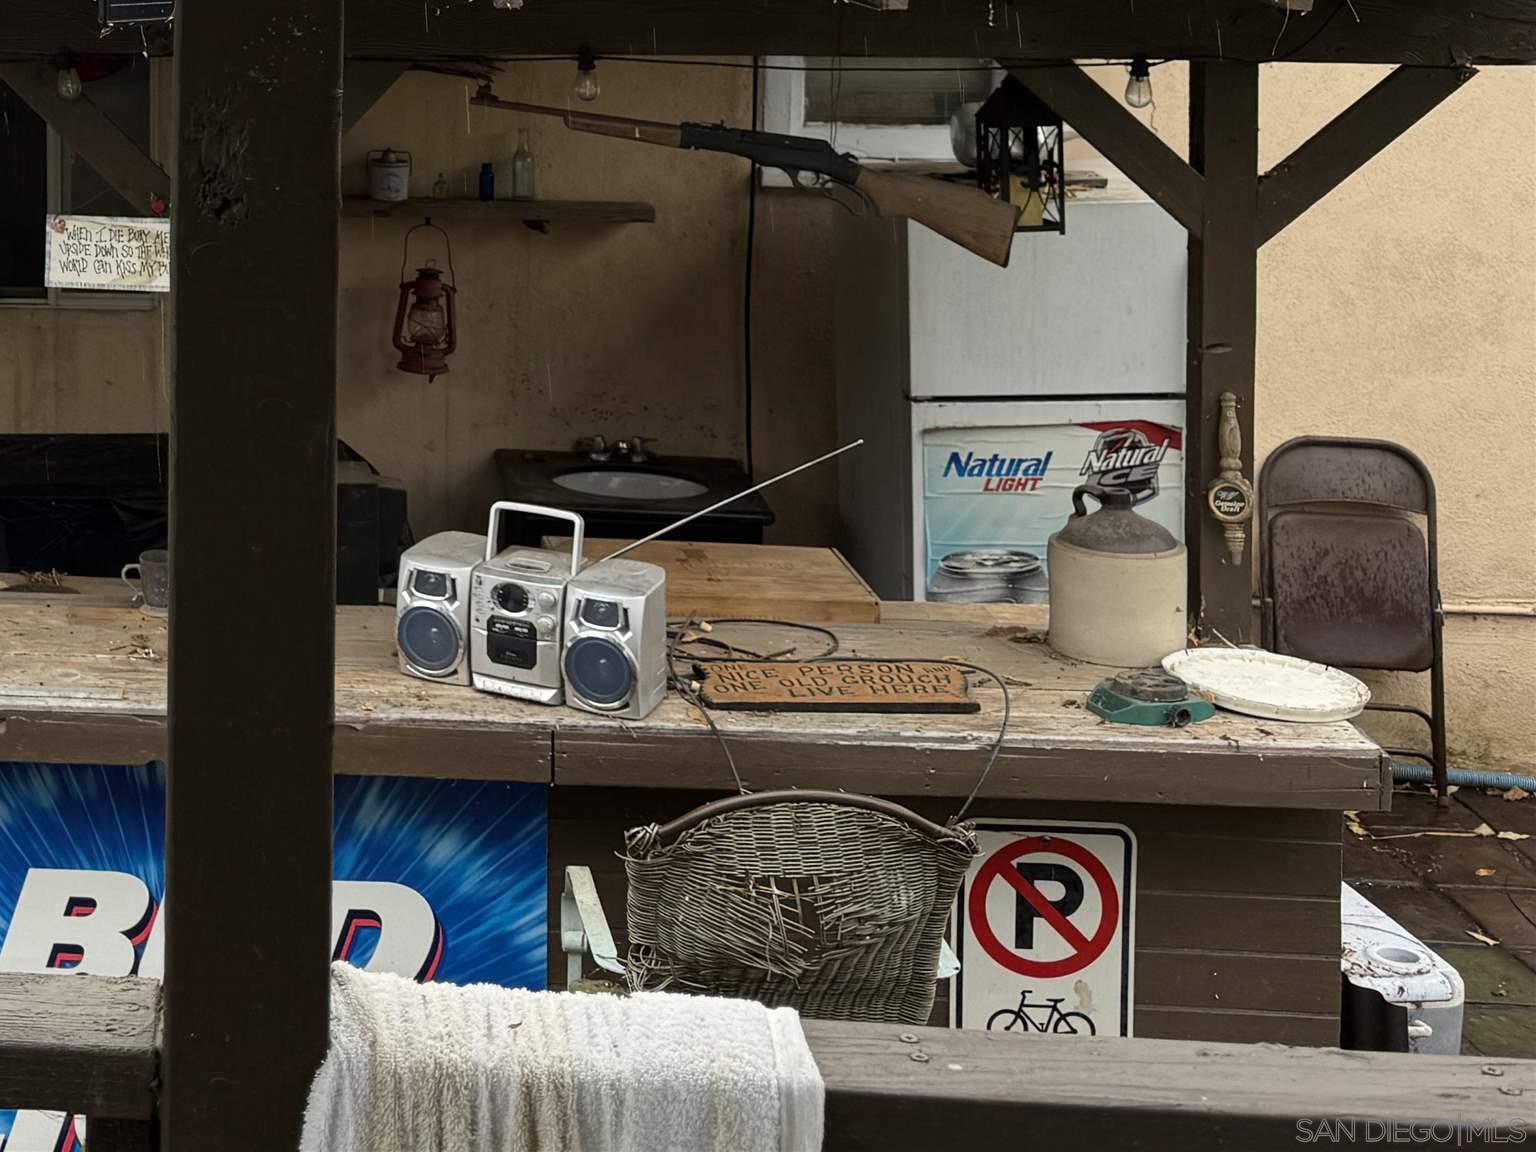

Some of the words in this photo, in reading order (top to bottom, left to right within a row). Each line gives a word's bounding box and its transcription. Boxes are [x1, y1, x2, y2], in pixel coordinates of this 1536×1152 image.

[96, 226, 107, 243] I
[108, 228, 124, 243] DIE
[127, 228, 151, 245] BURY
[59, 240, 92, 257] UPSIDE
[121, 244, 134, 258] SO
[59, 257, 88, 276] WORLD
[942, 451, 1053, 478] Natural
[1079, 438, 1170, 476] Natural
[983, 477, 1043, 492] LIGHT
[710, 664, 748, 673] ONE
[717, 668, 779, 684] NICE
[798, 663, 915, 677] PERSON
[713, 680, 767, 694] ONE
[778, 676, 829, 689] OLD
[841, 673, 952, 685] GROUCH
[787, 685, 856, 698] LIVE
[868, 684, 951, 696] HERE
